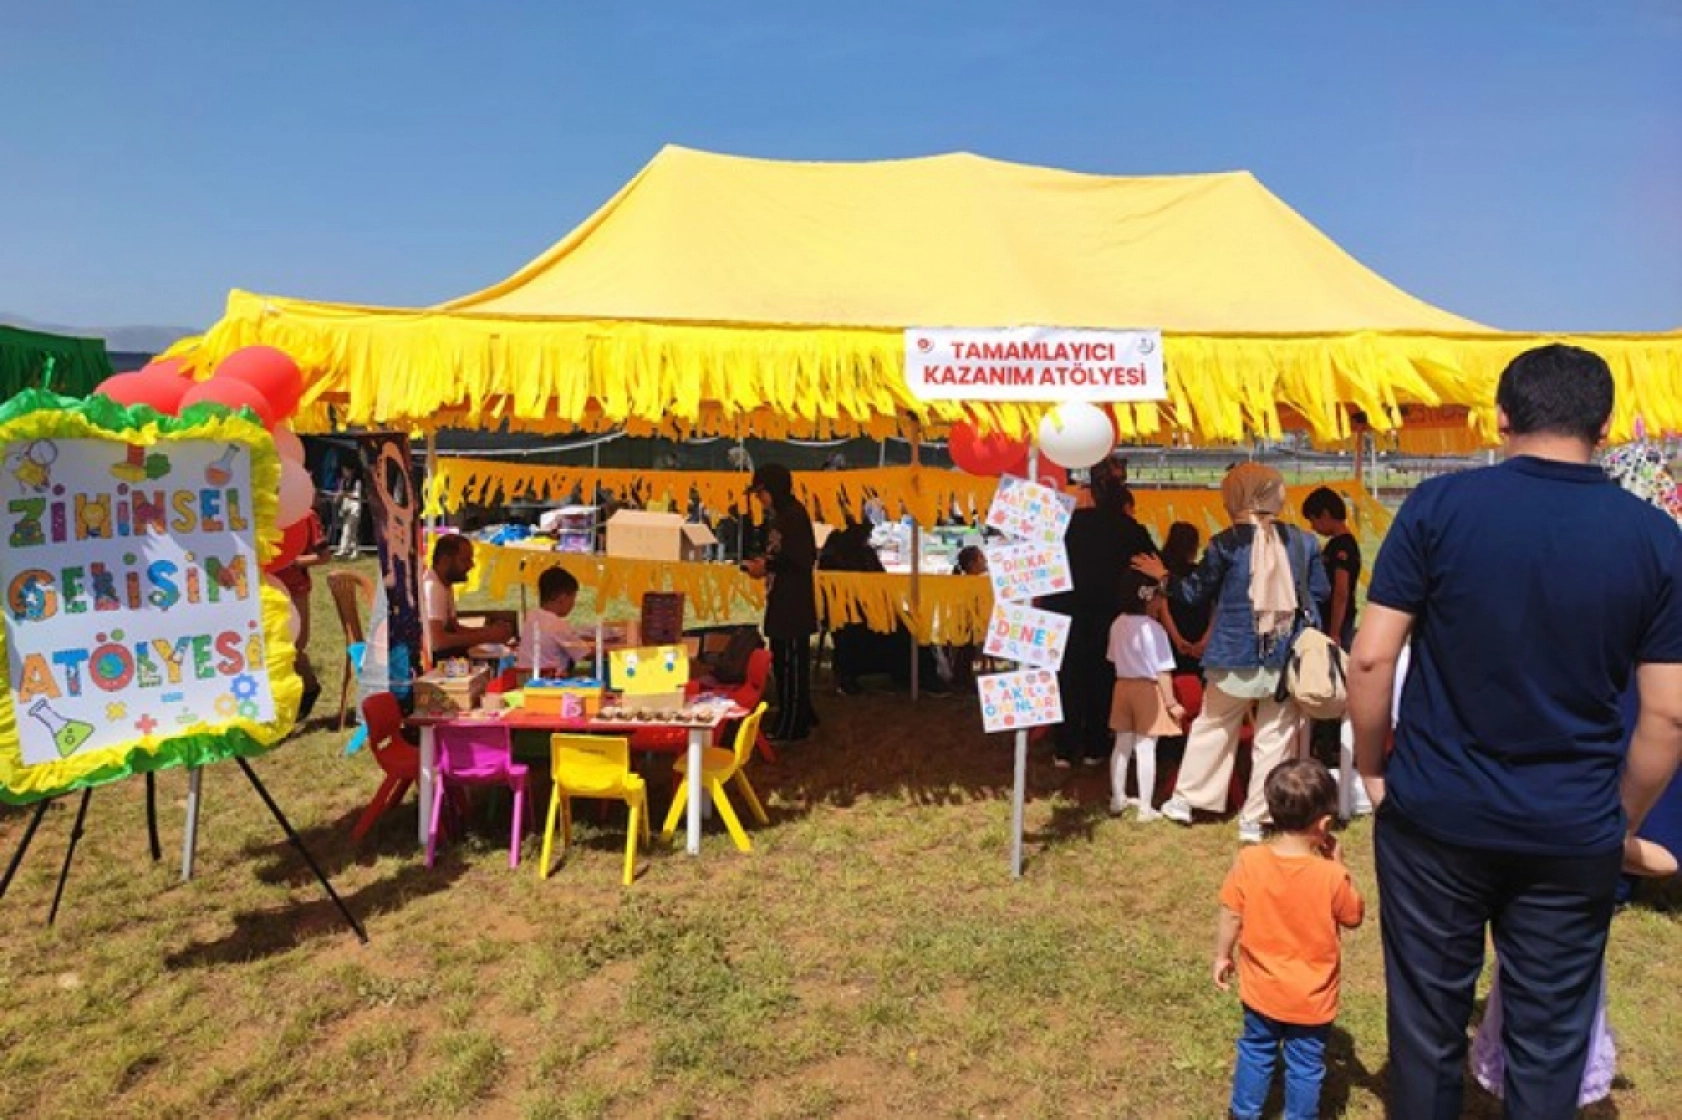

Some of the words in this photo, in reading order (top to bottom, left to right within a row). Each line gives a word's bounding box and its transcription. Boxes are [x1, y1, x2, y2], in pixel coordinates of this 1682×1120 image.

[923, 365, 1035, 386] KAZANIM
[1039, 363, 1147, 386] ATÖLYESİ
[951, 341, 1116, 361] TAMAMLAYICI
[7, 483, 249, 548] ZİHİNSEL
[7, 552, 249, 623] GELİŞİM
[996, 618, 1058, 649] DENEY
[18, 620, 264, 704] ATÖLYESİ
